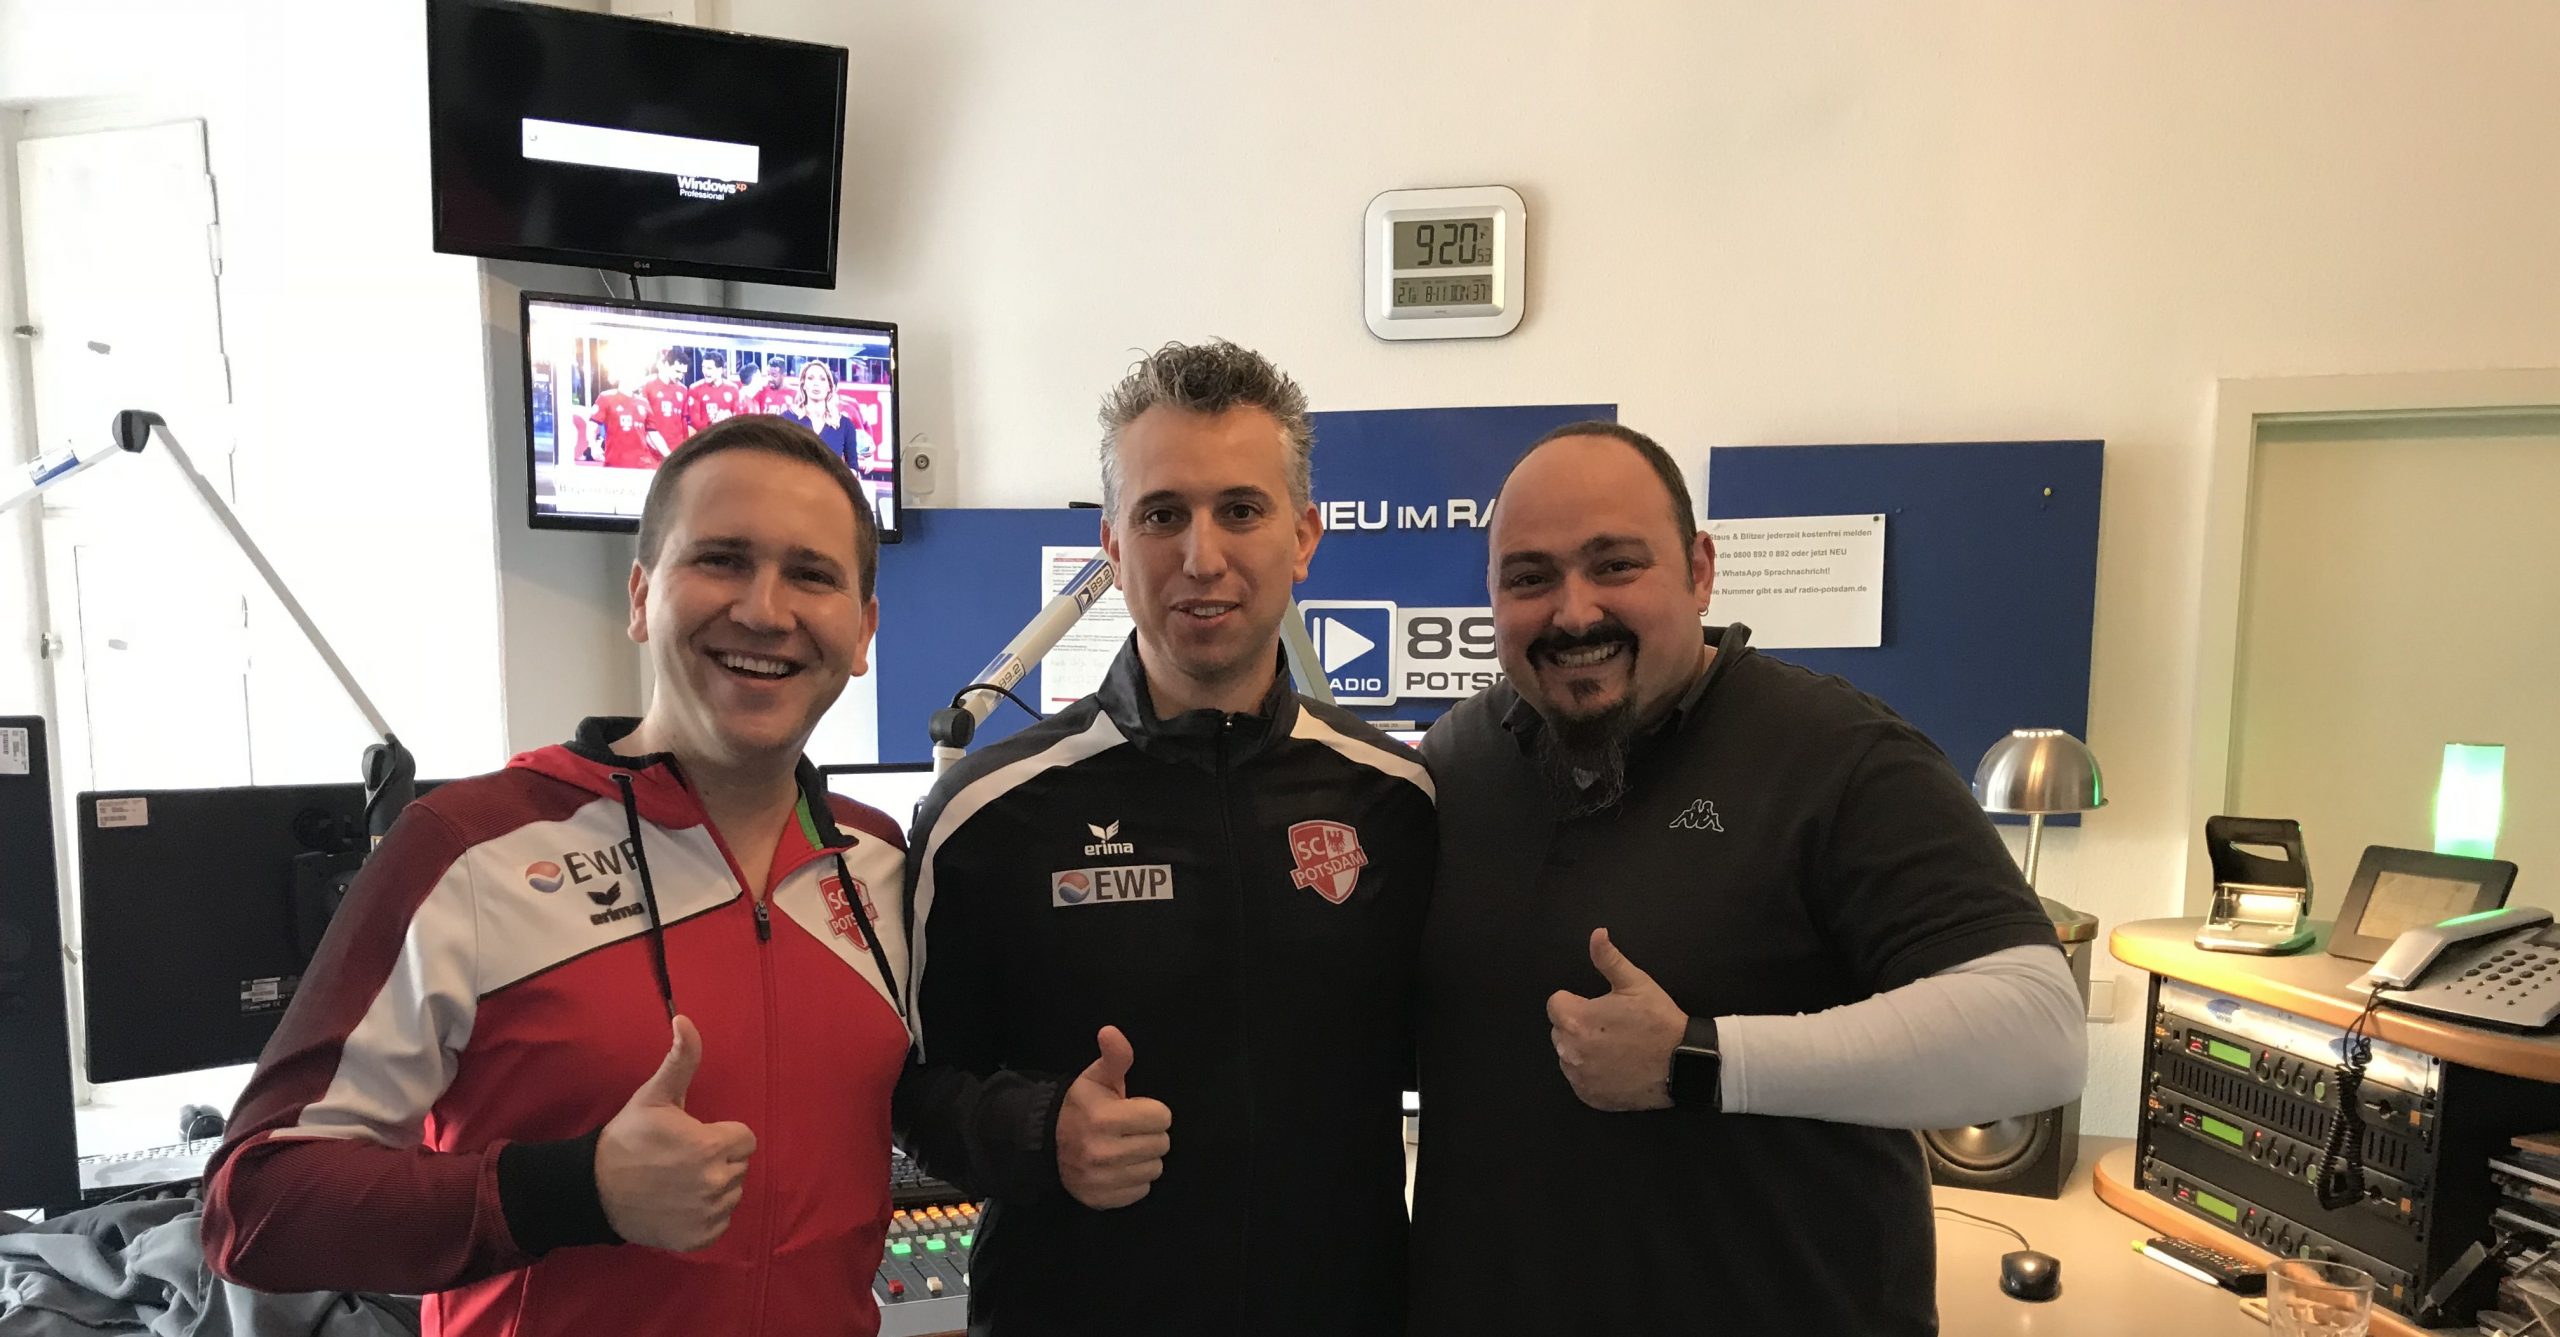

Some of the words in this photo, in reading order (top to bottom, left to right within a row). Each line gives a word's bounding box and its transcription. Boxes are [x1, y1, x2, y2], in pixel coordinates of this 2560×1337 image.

[677, 175, 736, 194] Windows
[679, 188, 725, 200] Professional
[1477, 248, 1492, 263] 53
[1397, 505, 1437, 529] IM
[1732, 532, 1738, 540] &
[1740, 532, 1766, 540] Blitzer
[1767, 531, 1800, 541] jederzeit
[1801, 529, 1841, 539] kostenfrei
[1843, 528, 1873, 537] melden
[1719, 551, 1731, 559] die
[1768, 550, 1774, 558] 0
[1791, 549, 1809, 557] oder
[1810, 548, 1828, 558] jetzt
[1829, 548, 1847, 556] NEU
[1090, 568, 1112, 593] 89.2
[1722, 569, 1762, 578] WhatsApp
[1764, 567, 1831, 578] Sprachnachricht!
[1721, 587, 1755, 596] Nummer
[1755, 586, 1771, 596] gibt
[1773, 587, 1783, 595] es
[1784, 586, 1798, 595] auf
[1798, 584, 1867, 596] radio-potsdam.de
[1406, 672, 1505, 692] POTS
[1084, 839, 1134, 856] erima
[1296, 836, 1326, 861] SC
[562, 837, 639, 885] EWP
[1295, 851, 1364, 885] POTSDAM
[1094, 867, 1168, 901] EWP
[590, 901, 645, 926] erima
